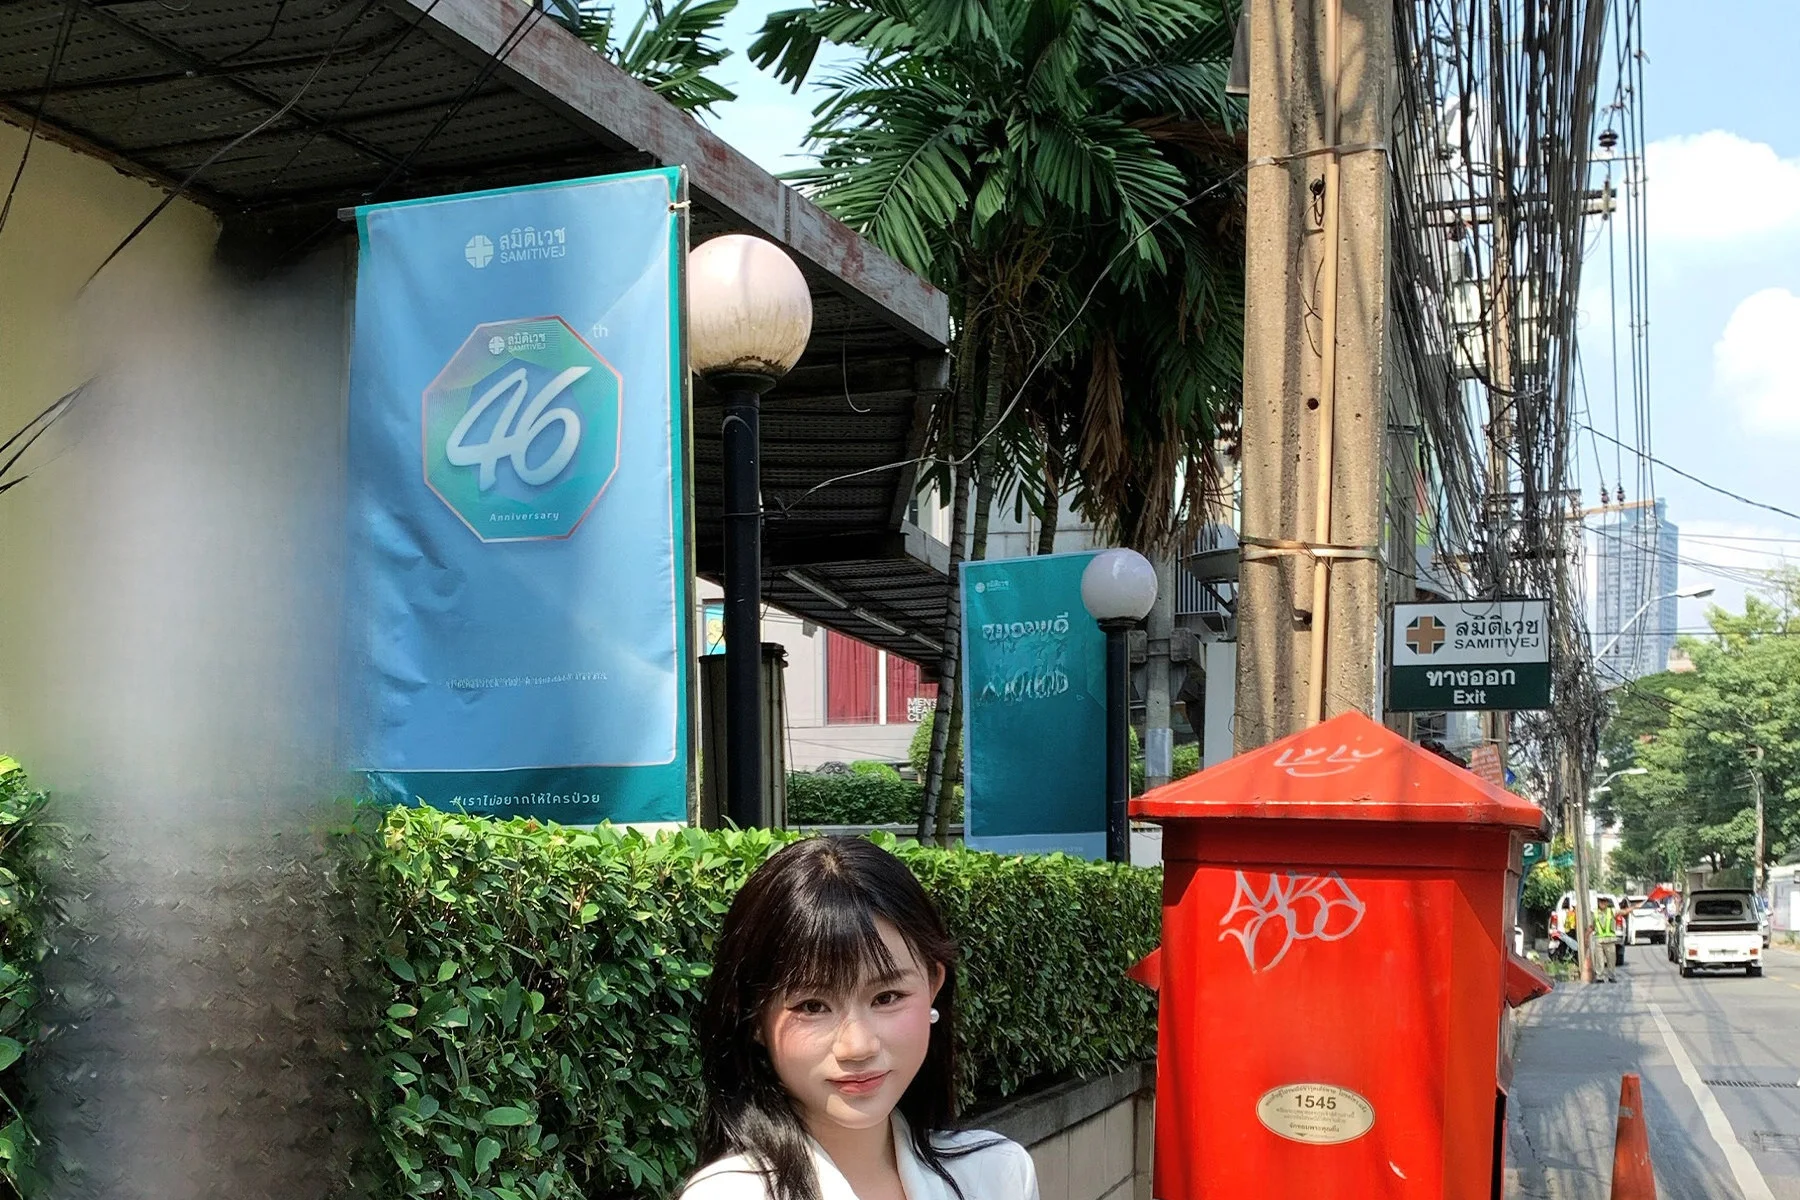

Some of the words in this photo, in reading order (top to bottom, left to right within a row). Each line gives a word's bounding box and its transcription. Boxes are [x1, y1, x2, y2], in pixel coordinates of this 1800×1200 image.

[499, 226, 566, 249] สมิติเวช
[500, 246, 566, 264] SAMITIVEJ
[446, 366, 592, 491] 46
[490, 511, 560, 522] Anniversary
[1455, 614, 1539, 637] สมิติเวช
[1454, 637, 1539, 649] SAMITIVEJ
[1426, 668, 1516, 687] ทางออก
[1453, 690, 1486, 704] Exit
[1523, 843, 1535, 857] 2
[1295, 1094, 1337, 1110] 1545
